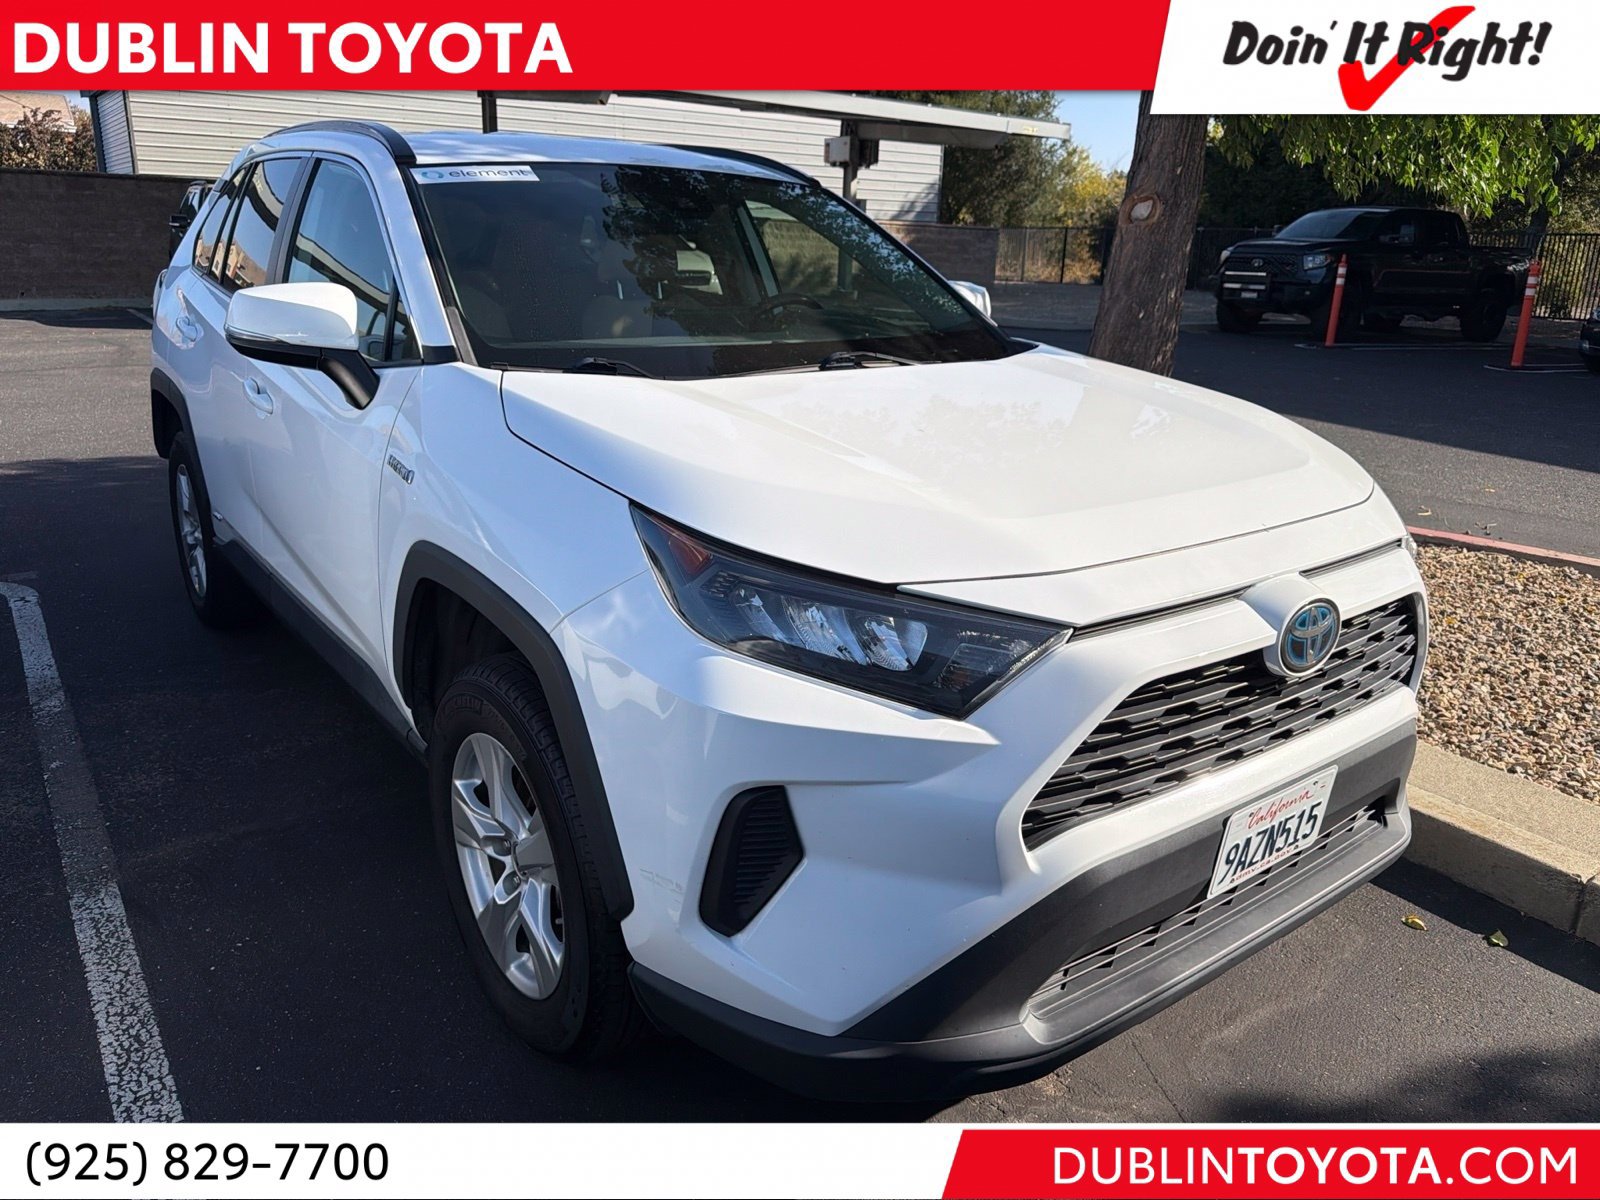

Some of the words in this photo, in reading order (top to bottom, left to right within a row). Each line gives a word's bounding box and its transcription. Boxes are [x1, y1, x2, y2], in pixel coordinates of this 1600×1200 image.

[448, 168, 525, 178] element
[1247, 788, 1314, 829] California
[1218, 801, 1322, 885] 9AZN515
